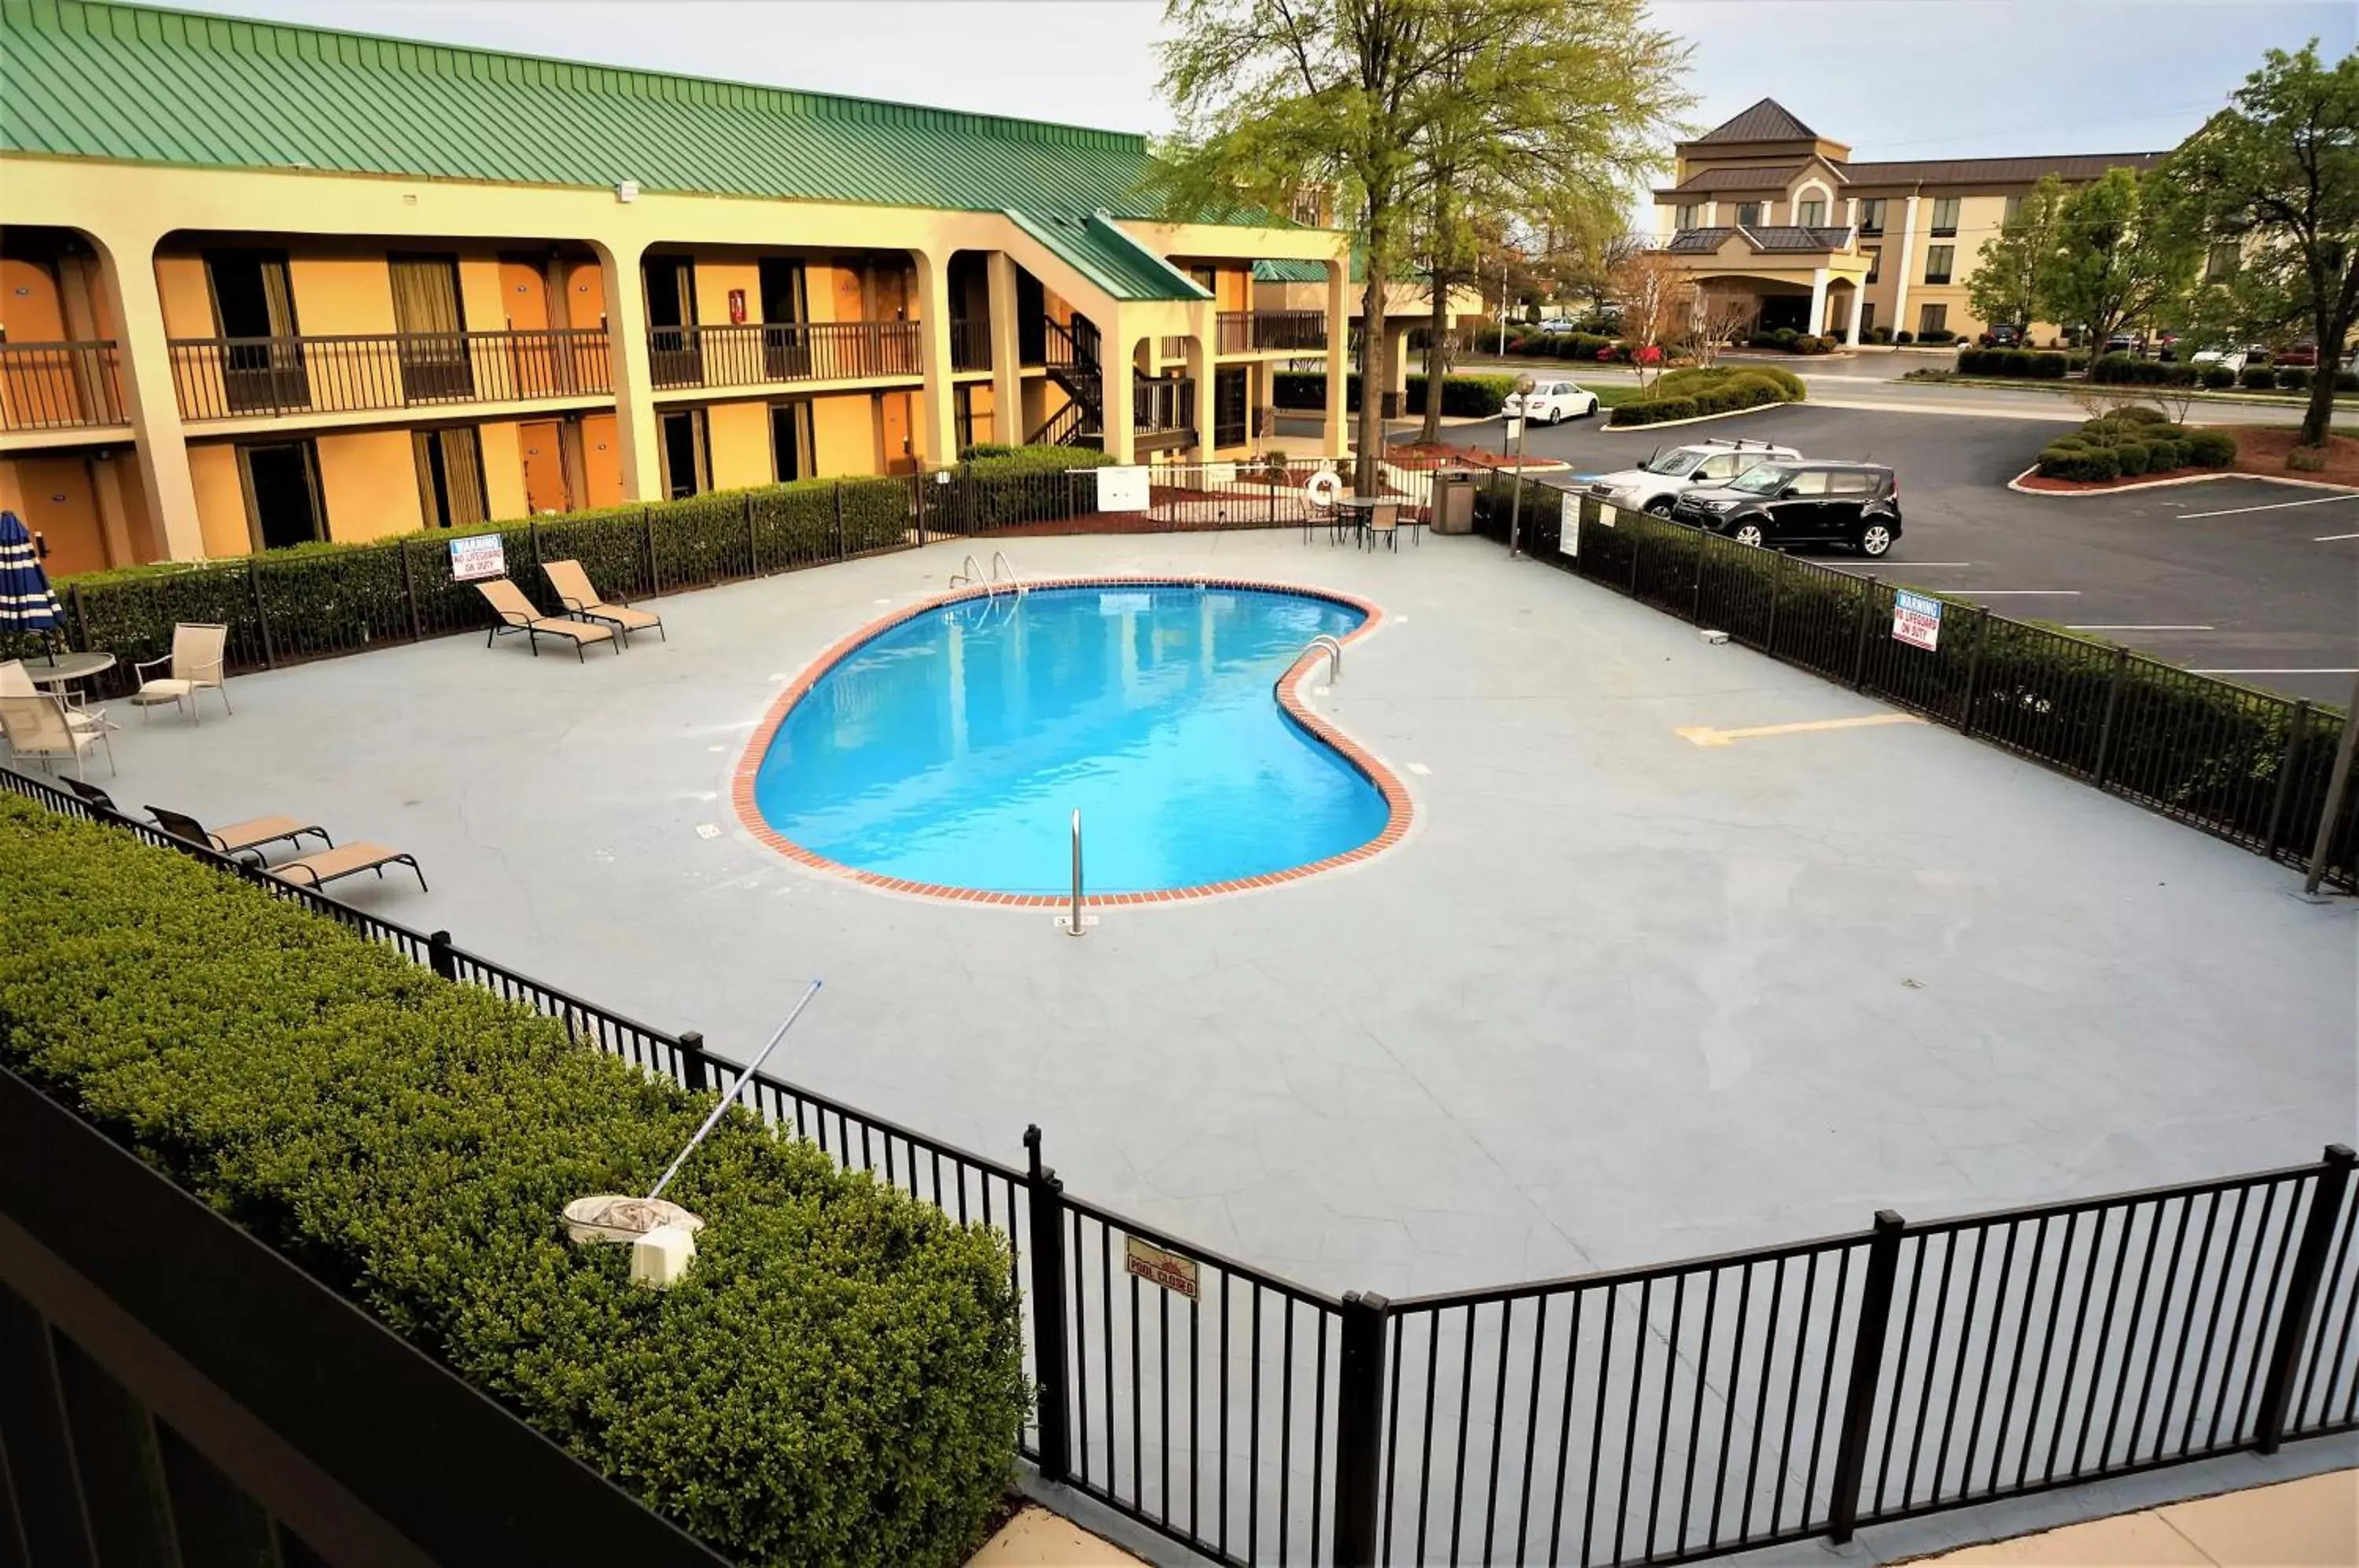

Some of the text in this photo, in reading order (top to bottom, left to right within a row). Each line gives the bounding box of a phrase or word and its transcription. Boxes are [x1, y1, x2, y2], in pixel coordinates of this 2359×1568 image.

[466, 550, 501, 561] LIFEGUARD
[466, 561, 494, 572] ON DUTY
[1899, 594, 1938, 617] WARNING
[1896, 609, 1938, 629] NO LIFEGUARD
[1902, 622, 1927, 640] ON DUTY
[1132, 1258, 1193, 1294] POOL CLOSED
